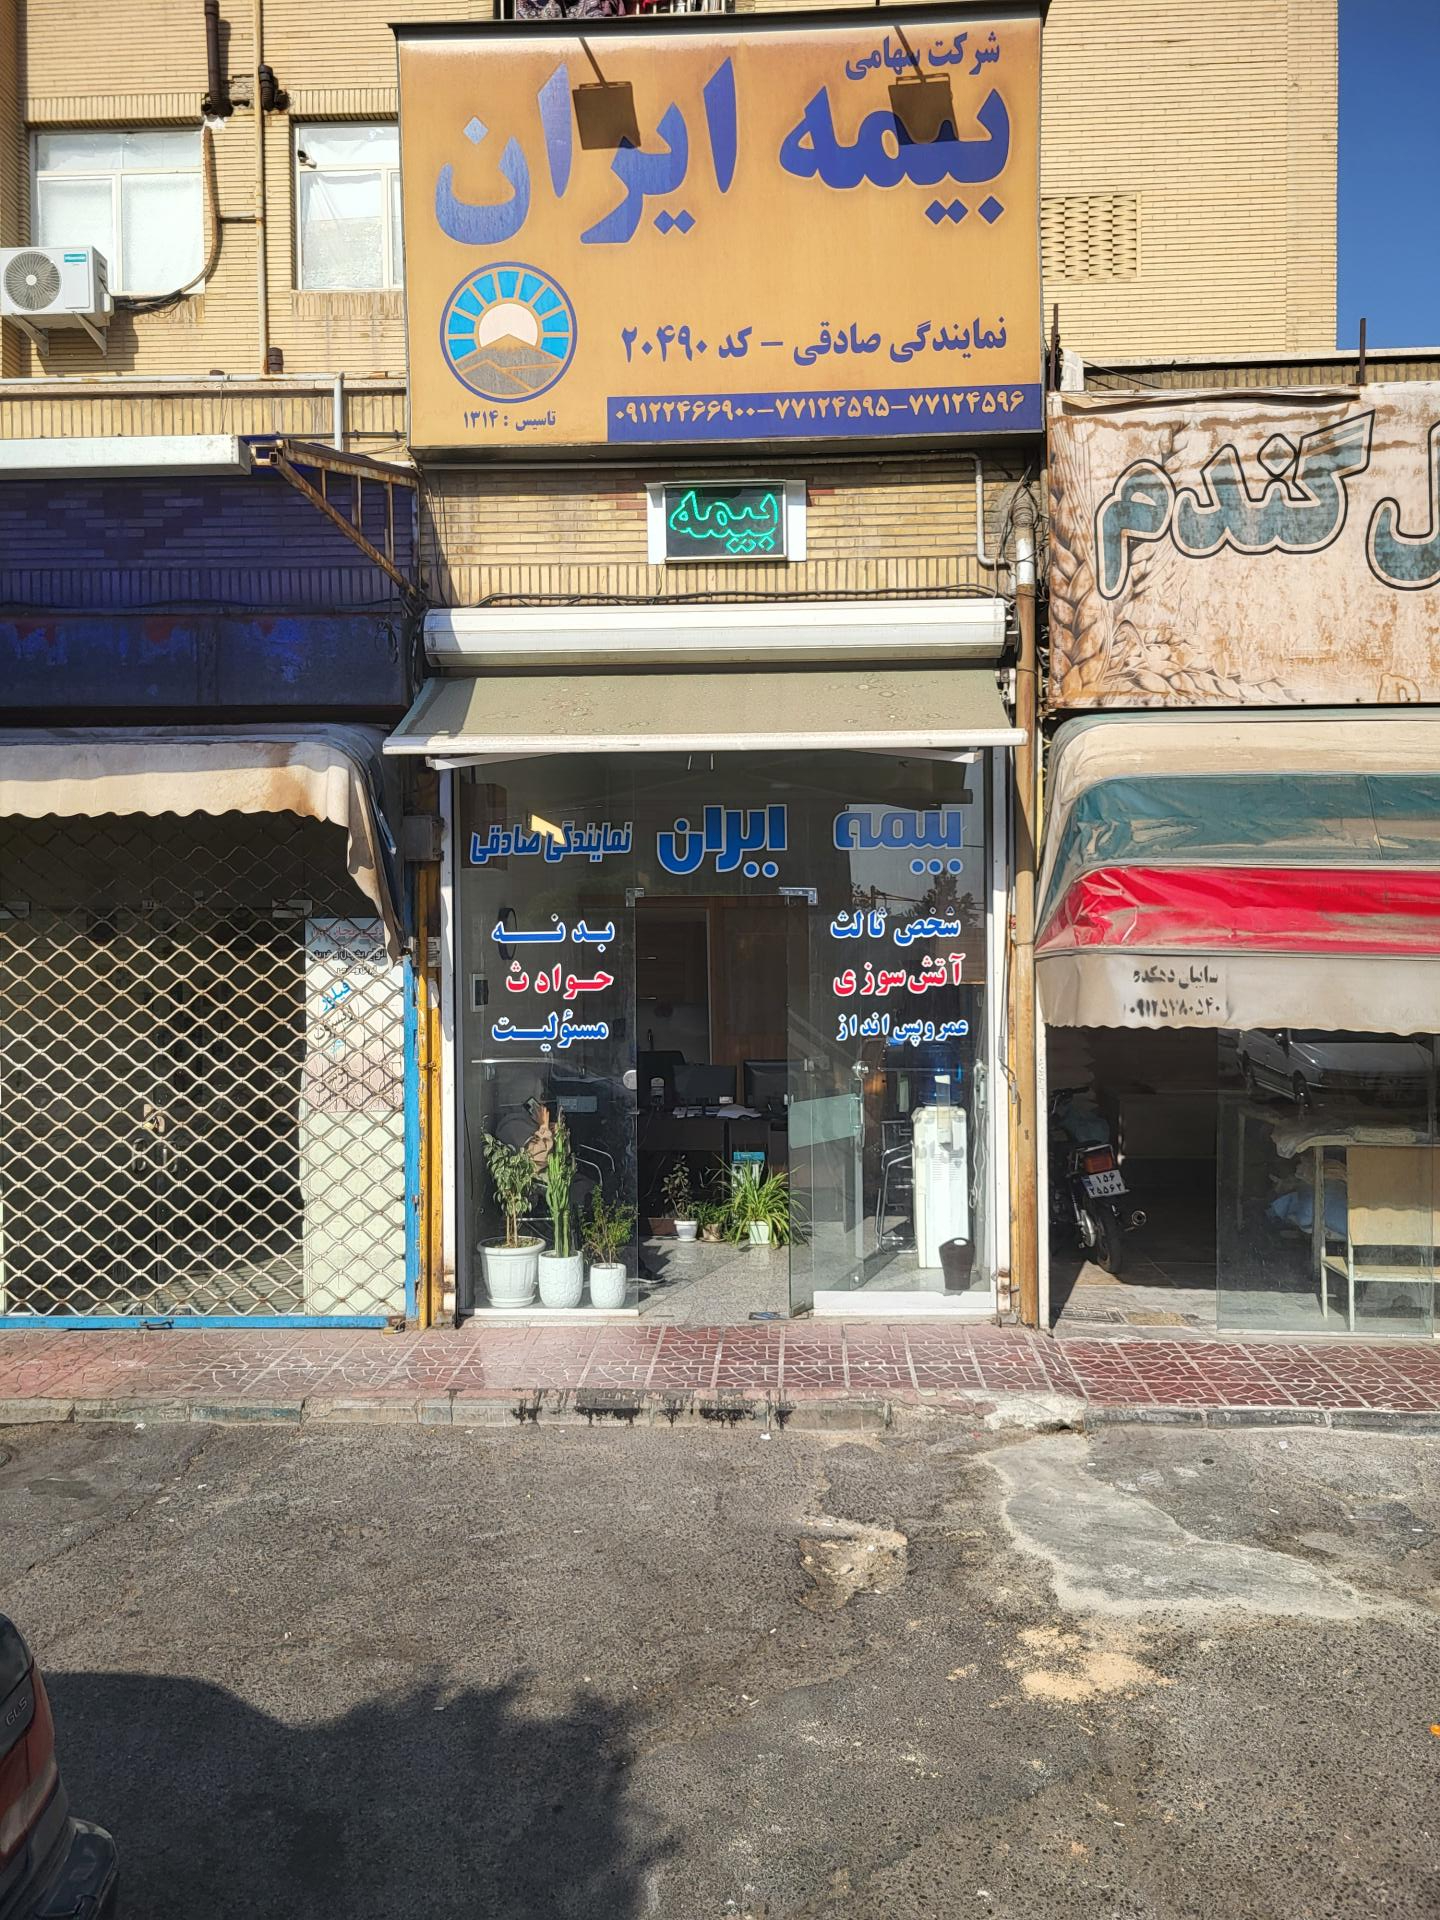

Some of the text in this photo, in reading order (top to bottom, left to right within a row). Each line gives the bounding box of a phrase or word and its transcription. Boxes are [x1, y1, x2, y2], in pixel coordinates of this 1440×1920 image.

[845, 31, 1000, 81] شرکت سهامی
[435, 56, 1011, 246] بیمه ایران
[621, 324, 708, 363] ۲۰۴۹۰
[718, 326, 753, 358] کد
[793, 321, 882, 366] صادقی
[890, 316, 1007, 363] نمایندگی
[464, 410, 499, 429] ۱۳۱۴
[515, 410, 556, 431] تاسیس
[669, 490, 779, 554] بیمه
[1094, 409, 1377, 600] گندم
[469, 804, 964, 878] بیمه ایران نمایندگی صادقی
[491, 913, 615, 952] بدنه
[830, 906, 961, 946] شخص ثالث
[506, 960, 614, 1000] حوادث
[833, 952, 966, 997] آتش سوزی
[836, 1012, 890, 1041] انداز
[935, 1019, 969, 1041] عمر
